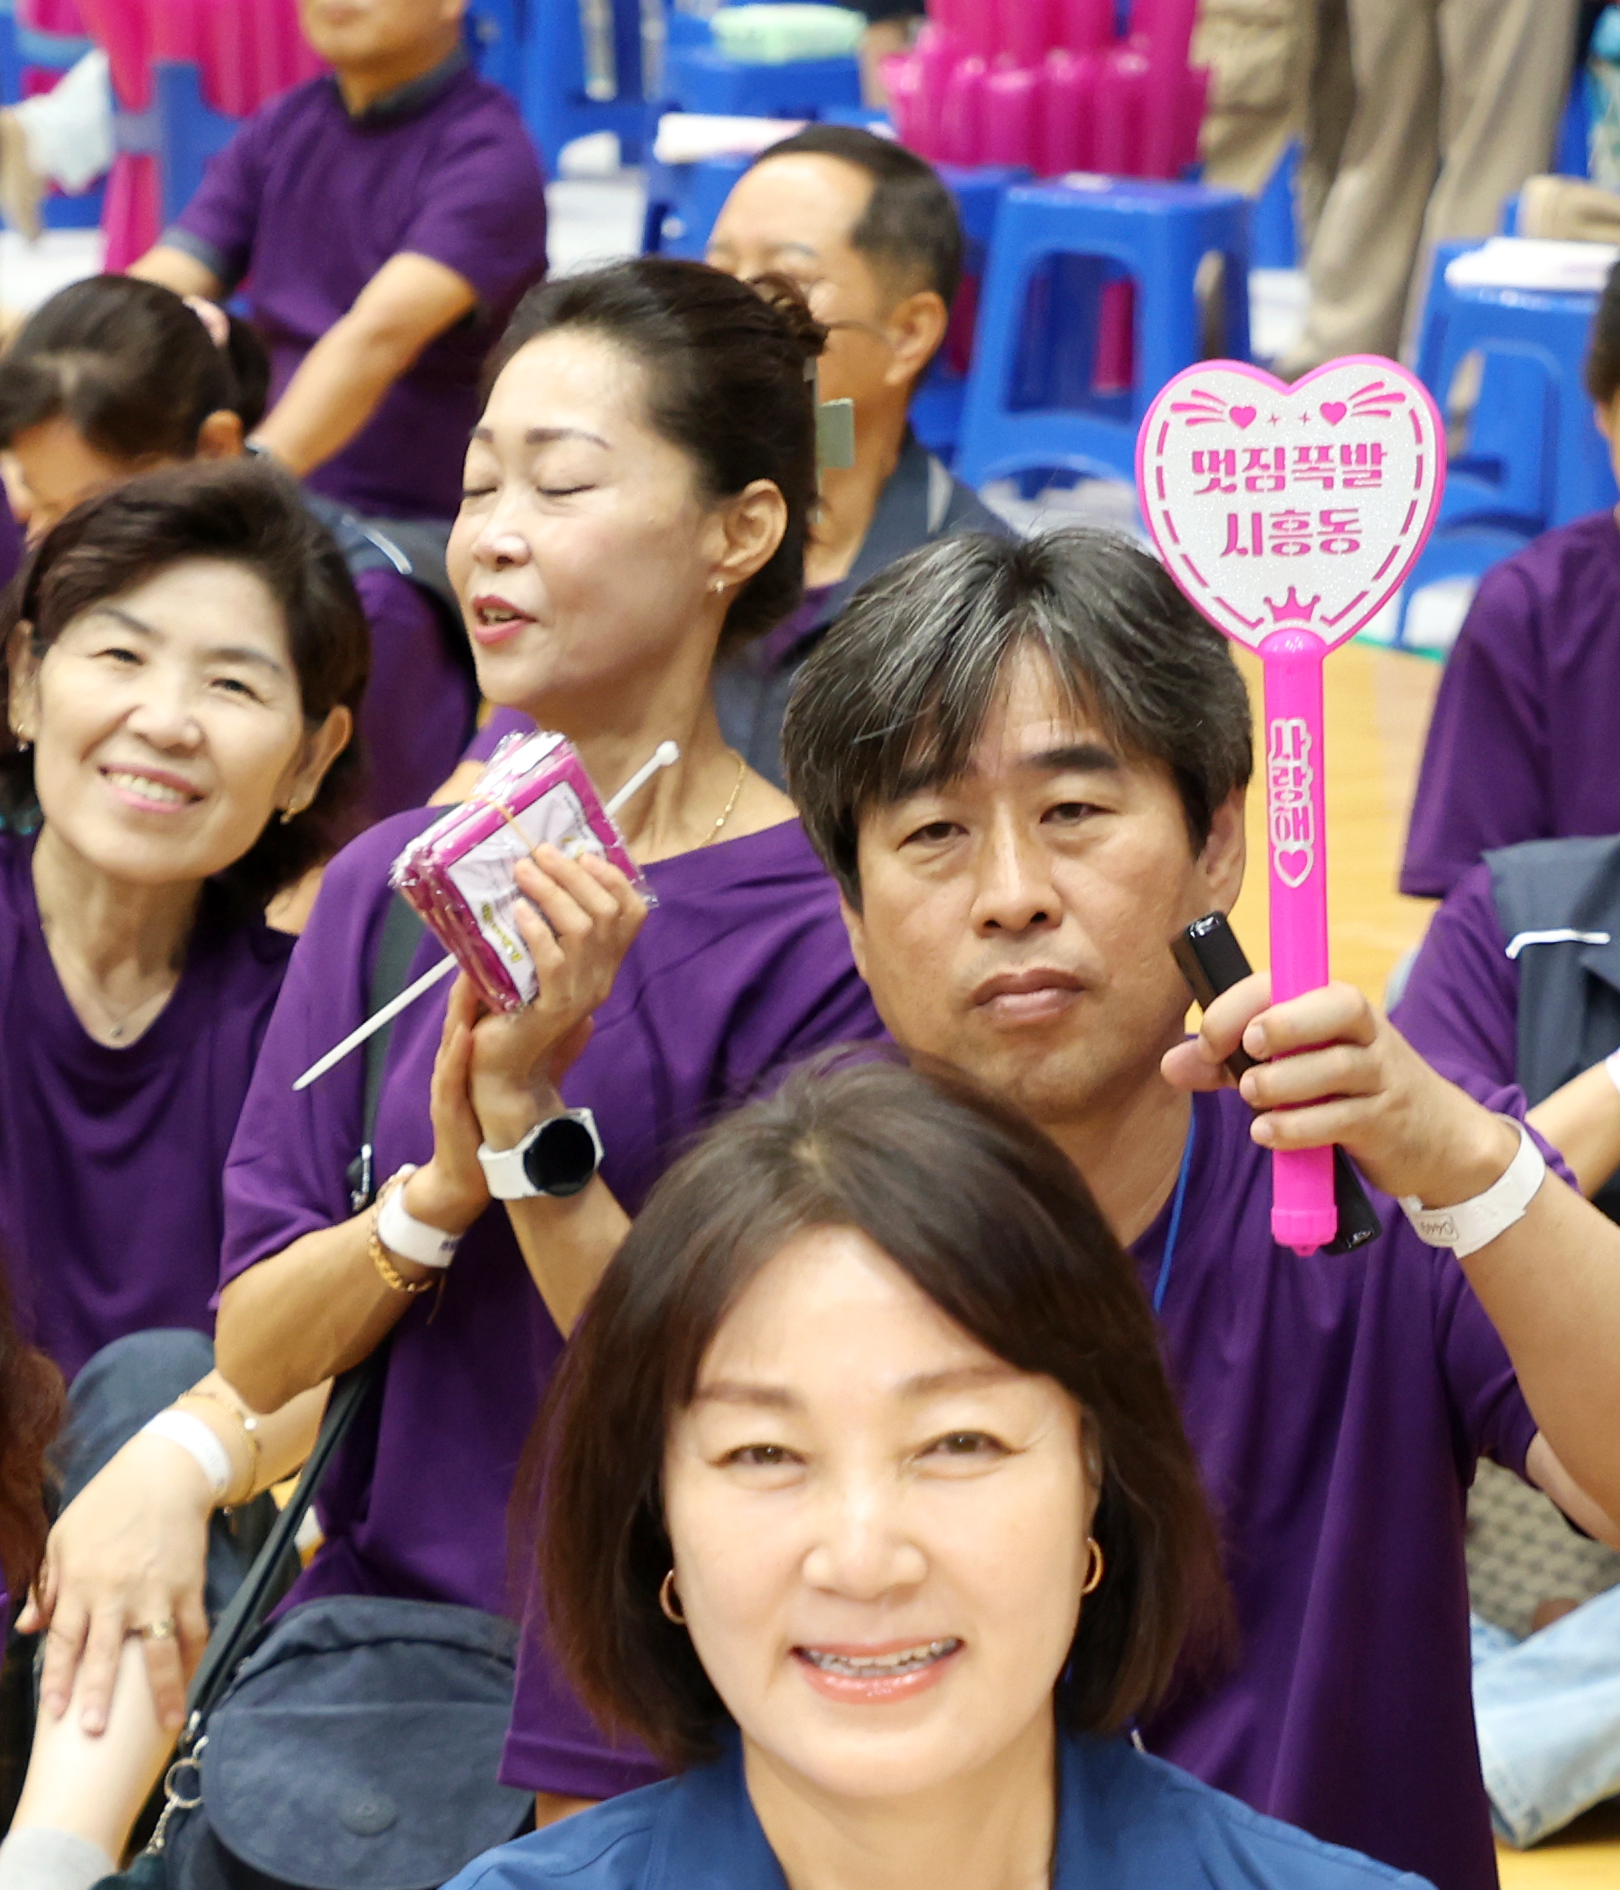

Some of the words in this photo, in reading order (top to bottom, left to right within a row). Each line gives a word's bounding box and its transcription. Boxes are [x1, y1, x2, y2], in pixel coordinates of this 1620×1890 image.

[1191, 442, 1387, 495] 멋짐폭발
[1220, 508, 1362, 558] 시흥동
[1269, 720, 1313, 845] 사랑해
